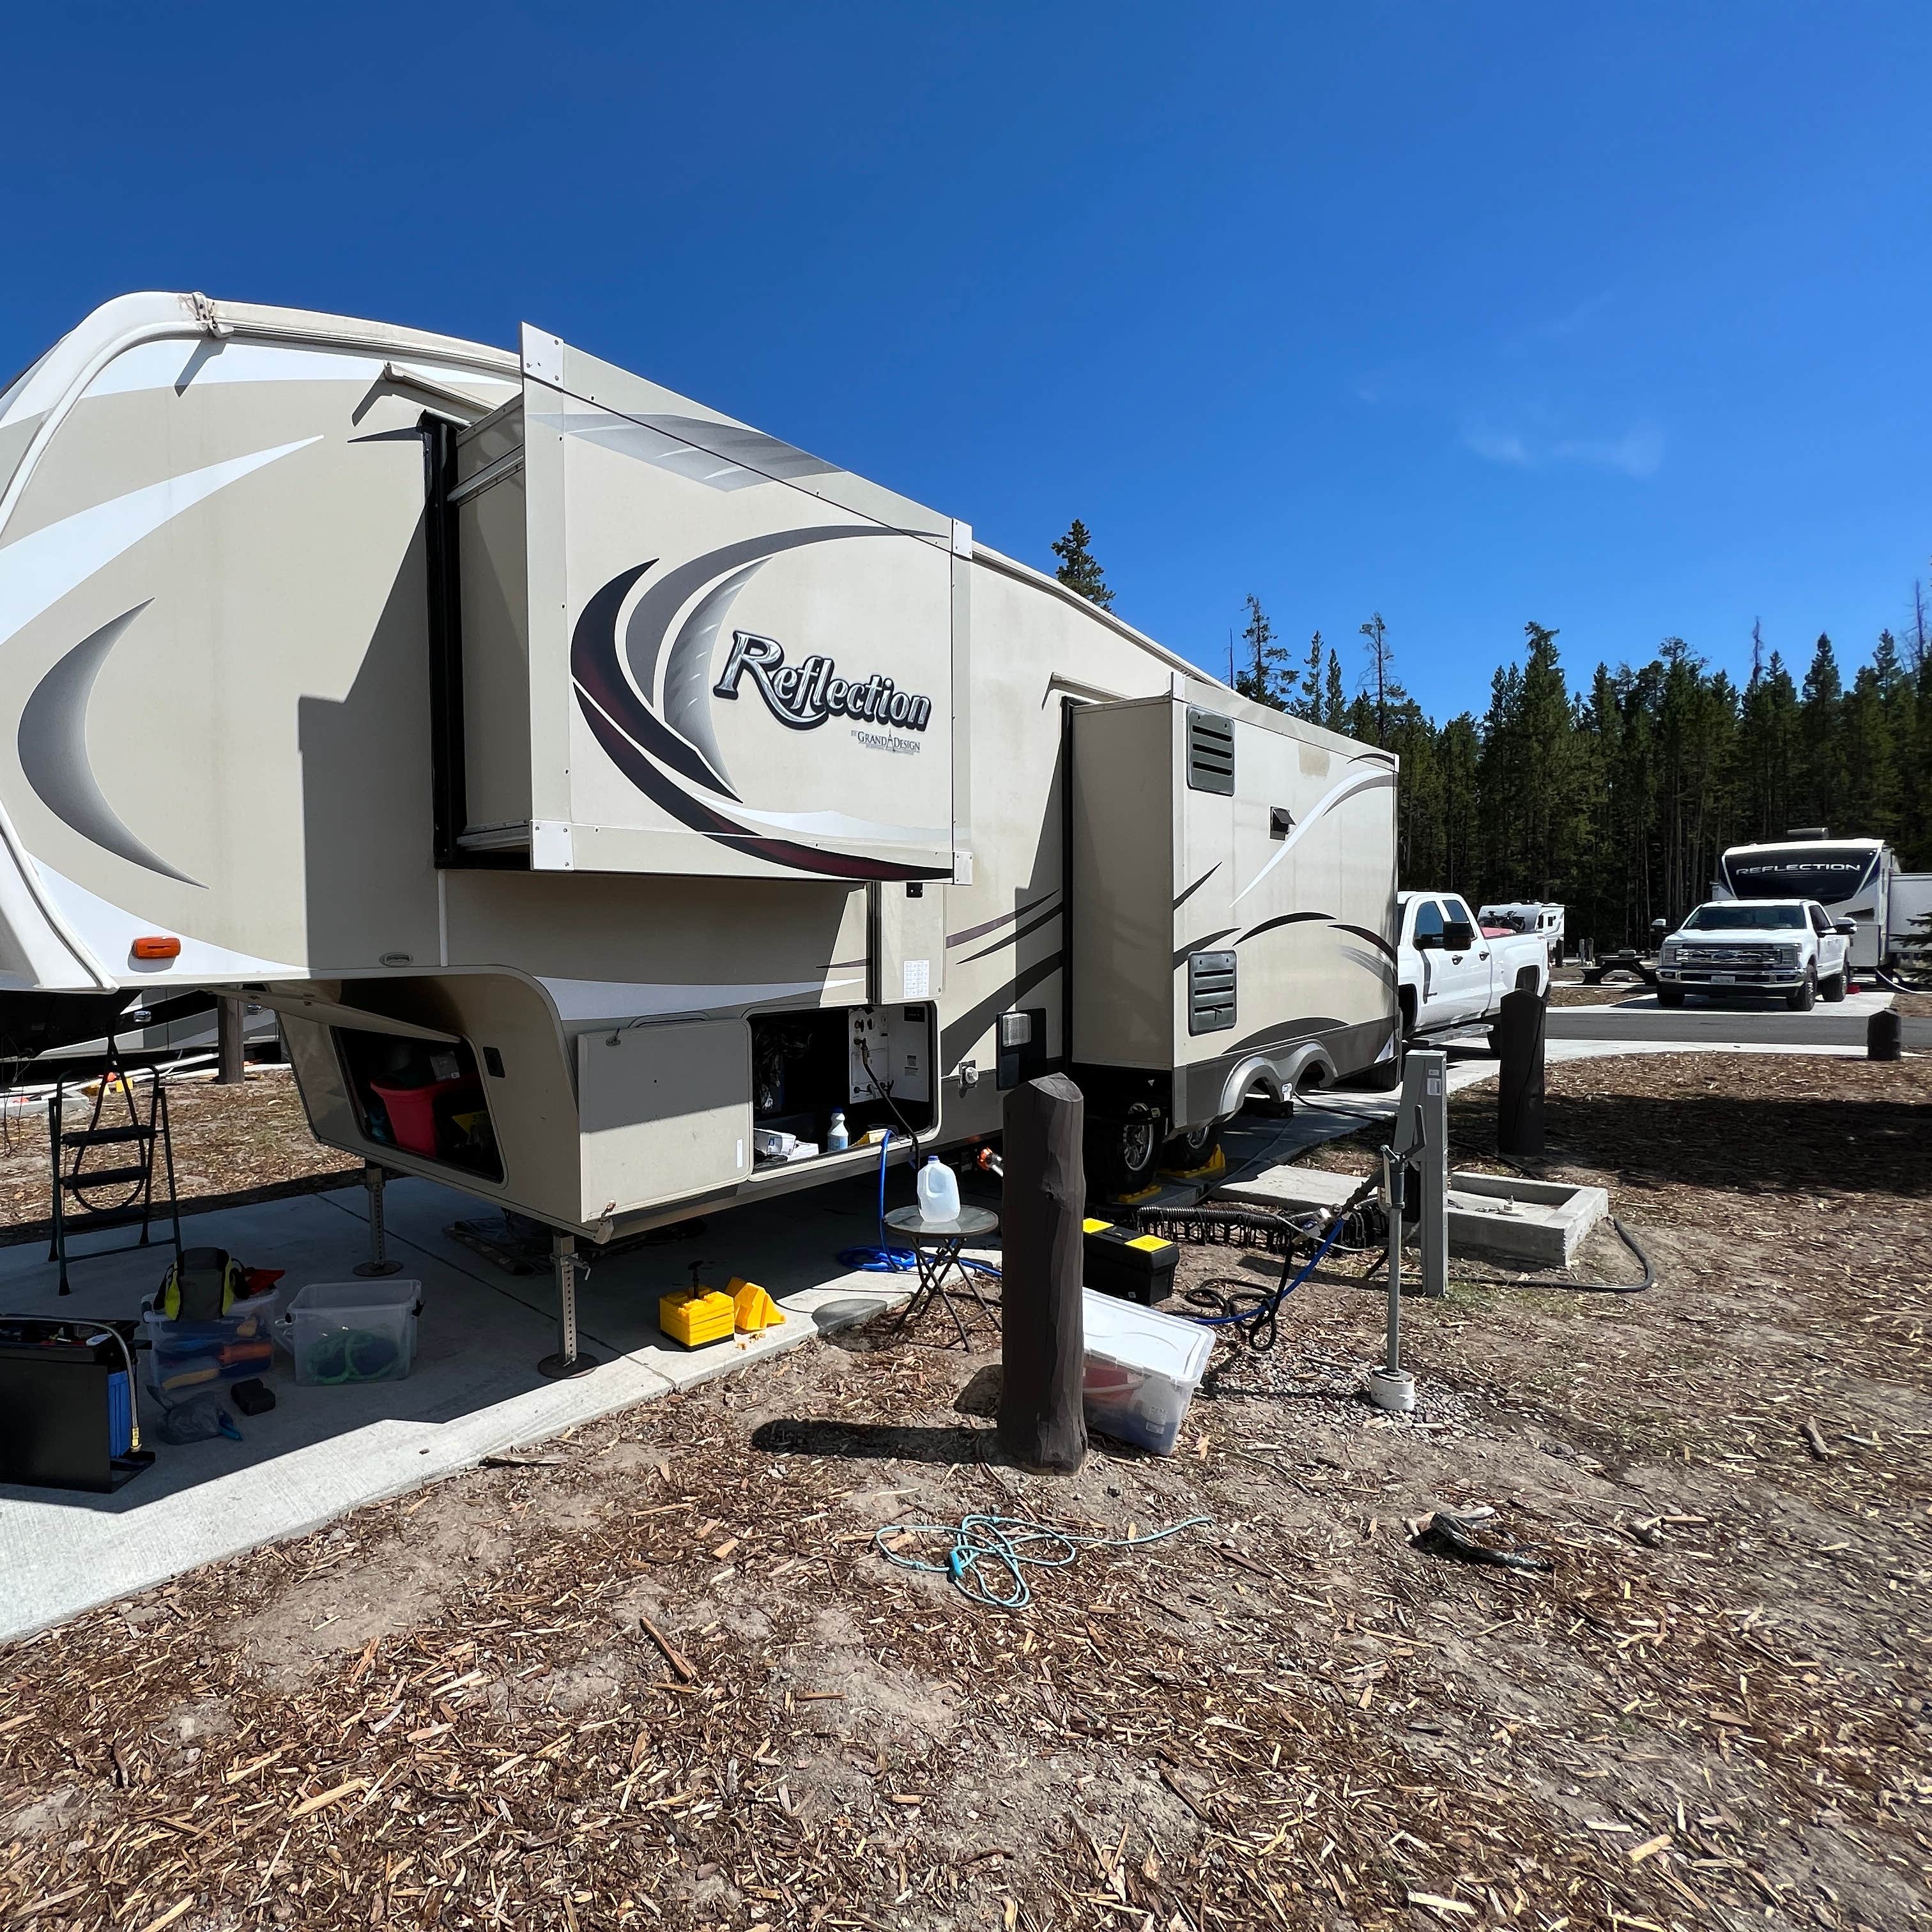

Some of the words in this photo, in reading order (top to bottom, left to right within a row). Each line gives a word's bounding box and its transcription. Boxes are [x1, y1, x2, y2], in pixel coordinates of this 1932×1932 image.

[713, 630, 931, 732] Reflection
[857, 731, 887, 746] GRAND
[894, 737, 921, 751] DESIGN
[1736, 864, 1860, 875] REFLECTION
